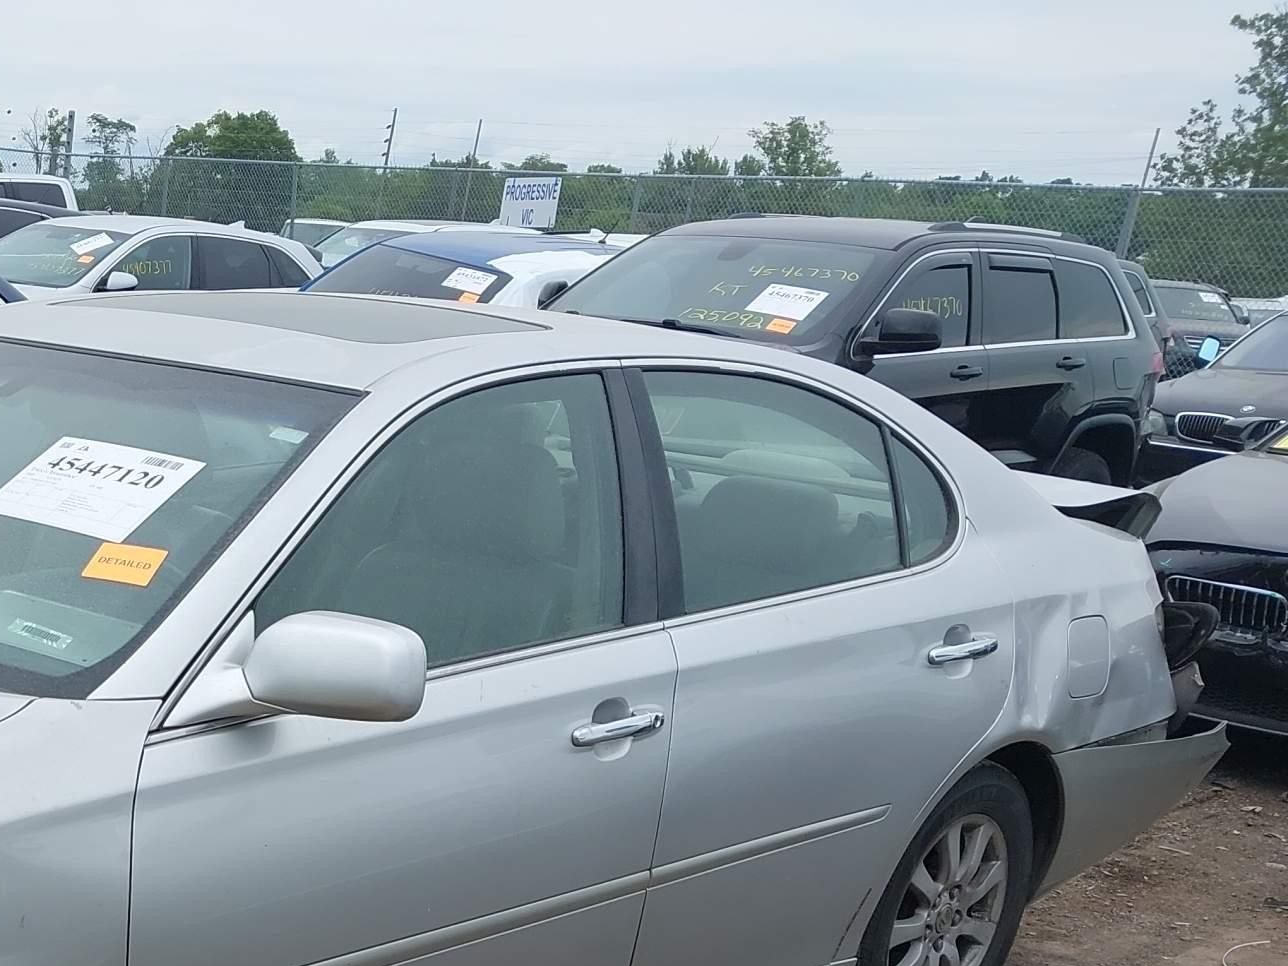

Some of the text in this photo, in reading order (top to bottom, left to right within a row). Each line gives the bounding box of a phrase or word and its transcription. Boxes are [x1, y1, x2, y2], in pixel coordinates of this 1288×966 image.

[504, 182, 558, 201] PROGRESSIVE
[521, 208, 534, 227] VIC
[47, 455, 165, 489] 45447120
[97, 556, 152, 570] DETAILED
